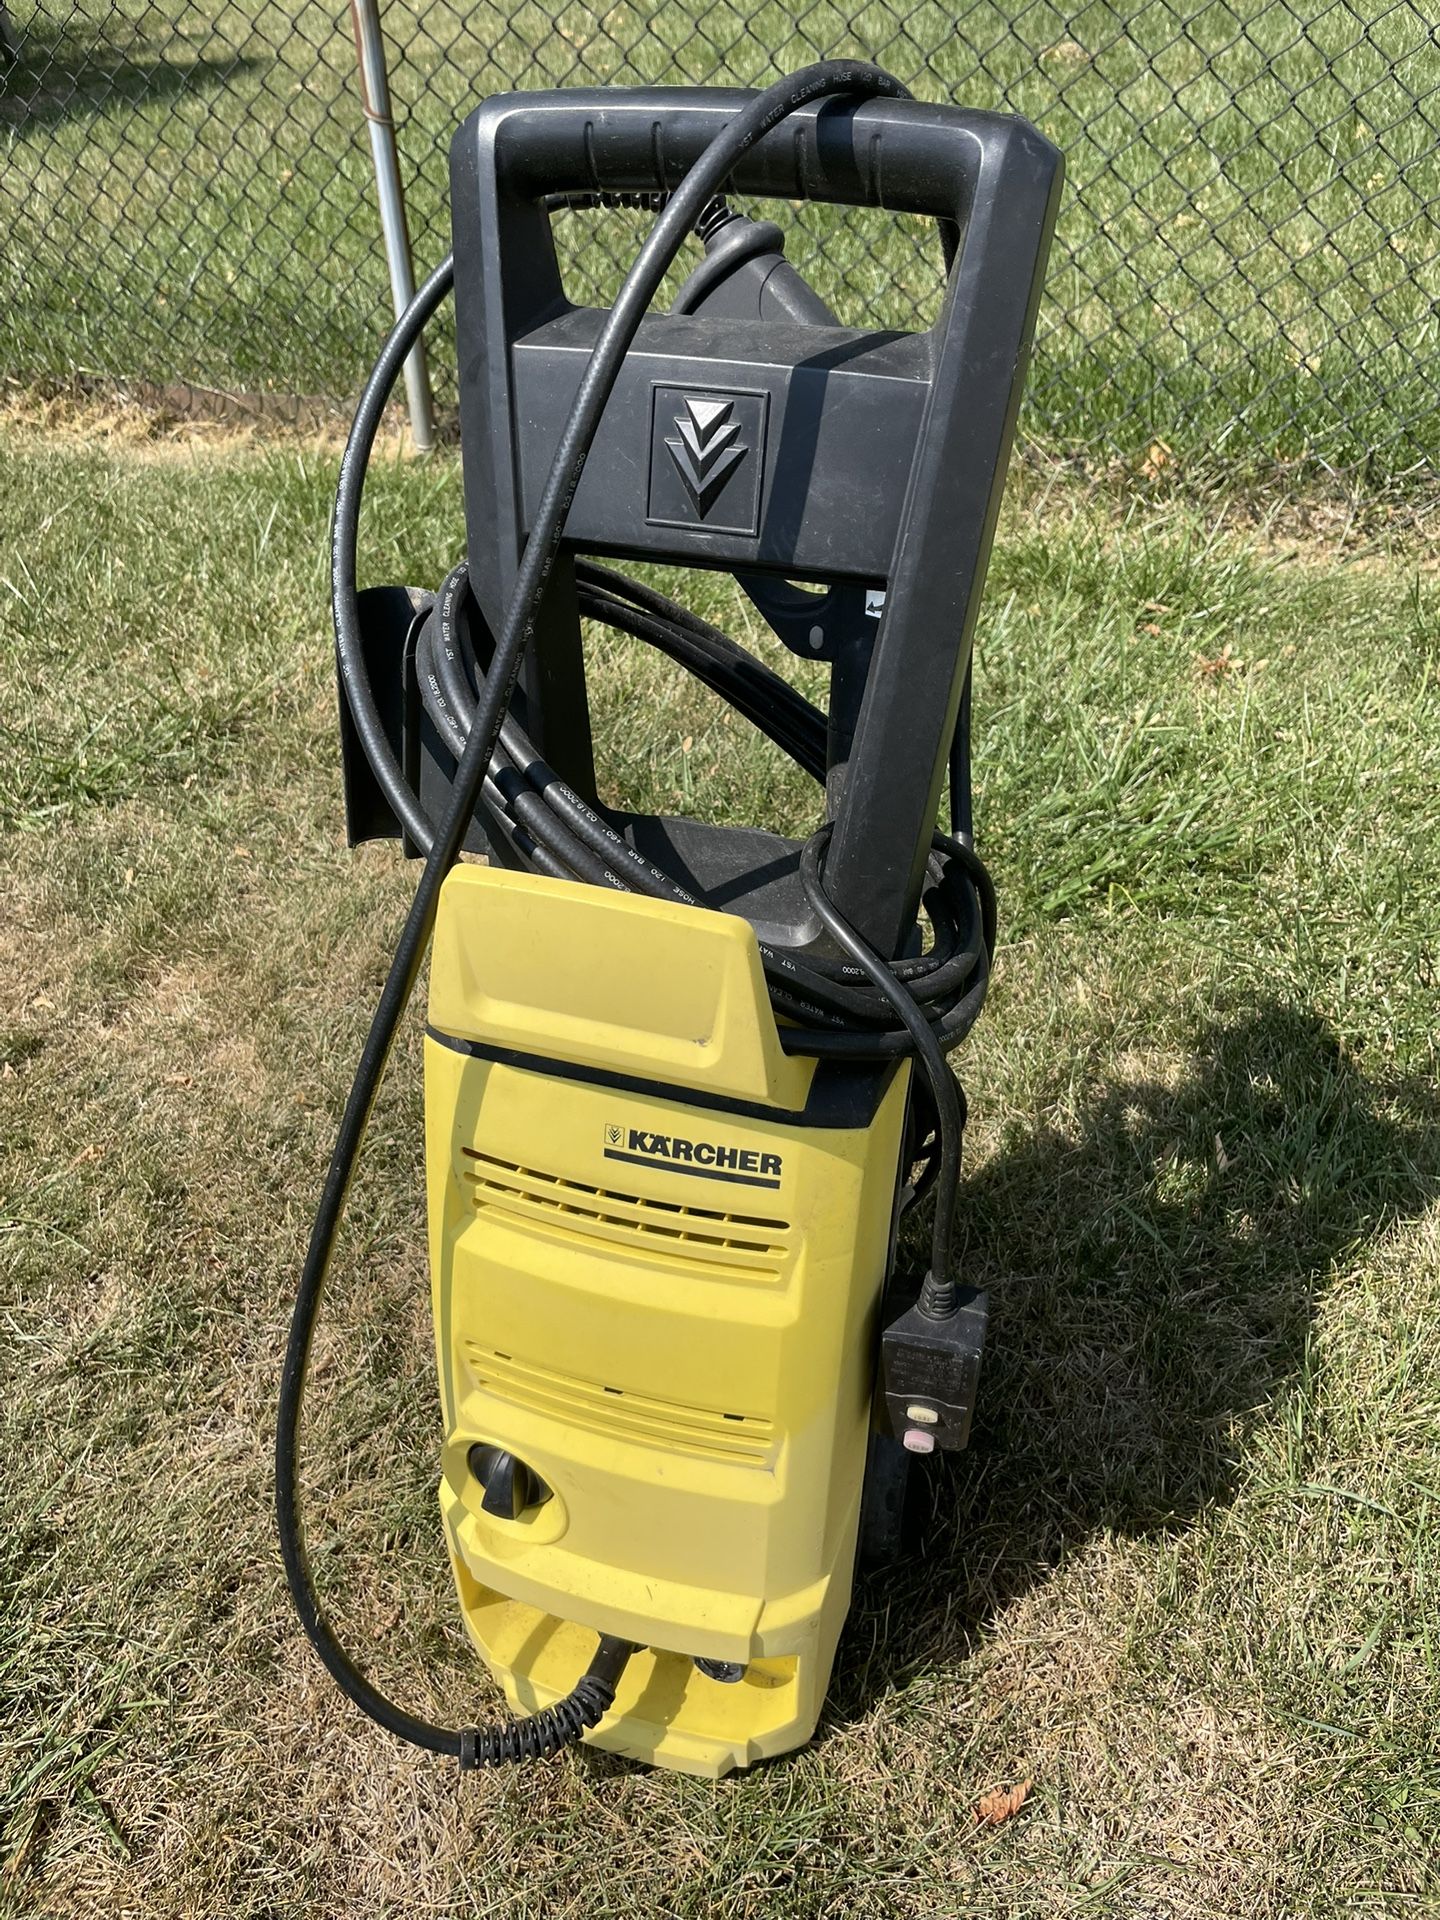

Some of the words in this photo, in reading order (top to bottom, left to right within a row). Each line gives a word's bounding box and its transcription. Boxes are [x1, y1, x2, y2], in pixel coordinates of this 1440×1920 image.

[759, 103, 785, 129] WATER
[791, 78, 826, 104] CLEANING
[832, 72, 852, 83] HOSE
[445, 648, 454, 661] YST
[627, 849, 646, 865] BAR
[650, 868, 666, 882] 120
[672, 886, 696, 904] HOSE
[781, 959, 796, 971] YST
[799, 999, 824, 1017] WATER
[629, 1129, 782, 1176] KÄRCHER
